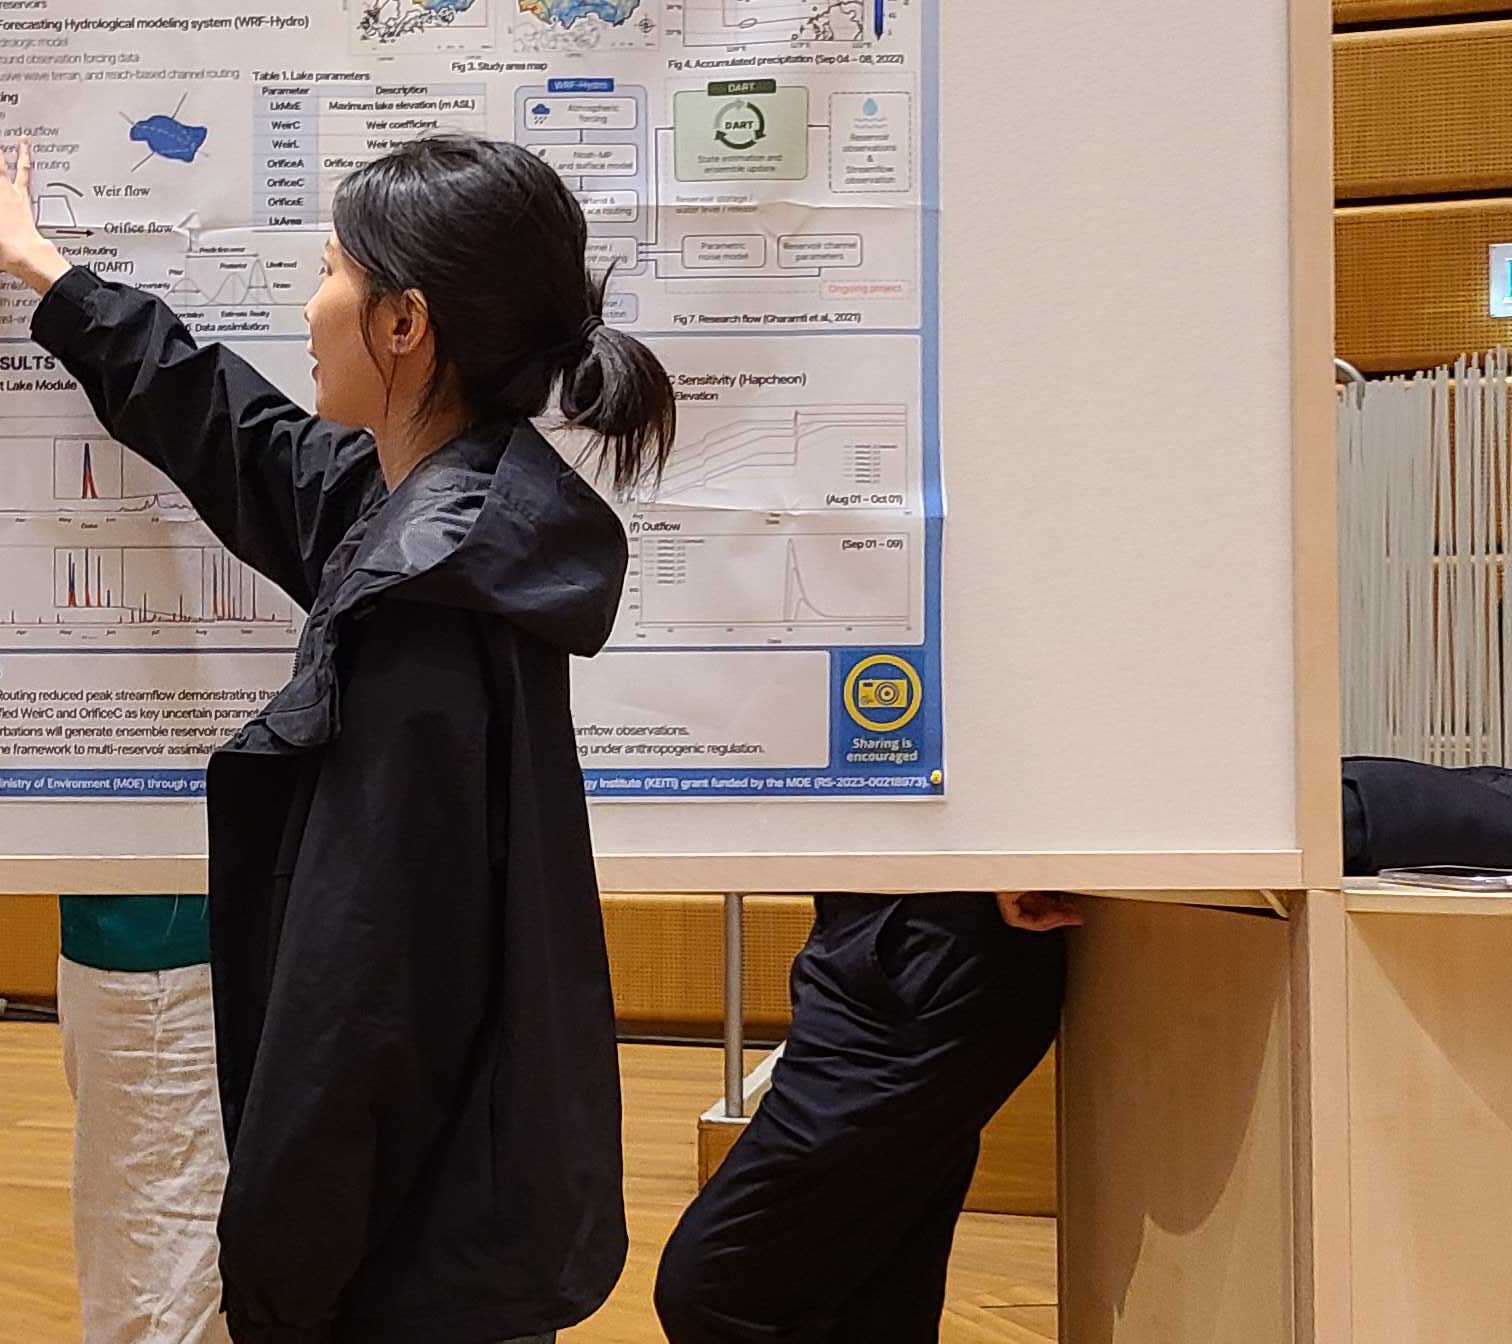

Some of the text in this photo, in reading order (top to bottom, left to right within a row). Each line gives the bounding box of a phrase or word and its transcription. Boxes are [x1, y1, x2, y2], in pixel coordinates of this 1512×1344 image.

[64, 18, 134, 31] Hydrological
[191, 18, 231, 30] system
[234, 16, 309, 30] (WRF-Hydro)
[253, 71, 282, 81] Table
[291, 71, 313, 80] Lake
[315, 71, 370, 81] parameters
[729, 83, 756, 93] DART
[725, 121, 754, 130] DART
[93, 185, 150, 197] Weir flow
[104, 222, 144, 234] Orifice
[6, 380, 32, 391] Lake
[35, 380, 77, 390] Module
[678, 373, 806, 387] Sensitivity (Hapcheon)
[642, 521, 680, 531] Outflow
[39, 689, 83, 700] reduced
[86, 690, 112, 702] peak
[115, 690, 175, 700] streamflow
[178, 688, 256, 702] demonstrating
[21, 708, 53, 719] WeirC
[56, 708, 76, 718] and
[79, 708, 122, 718] OrificeC
[139, 708, 159, 721] key
[162, 708, 211, 718] uncertain
[46, 726, 62, 736] will
[65, 727, 112, 739] generate
[115, 726, 168, 736] ensemble
[171, 726, 217, 736] reservoir
[13, 744, 71, 755] framework
[87, 744, 164, 755] multi-reservoir
[591, 743, 764, 754] under anthropogenic regulation.
[852, 738, 899, 751] Sharing
[847, 750, 917, 763] encouraged
[48, 778, 109, 788] Environment
[148, 779, 187, 791] through
[766, 777, 783, 788] the
